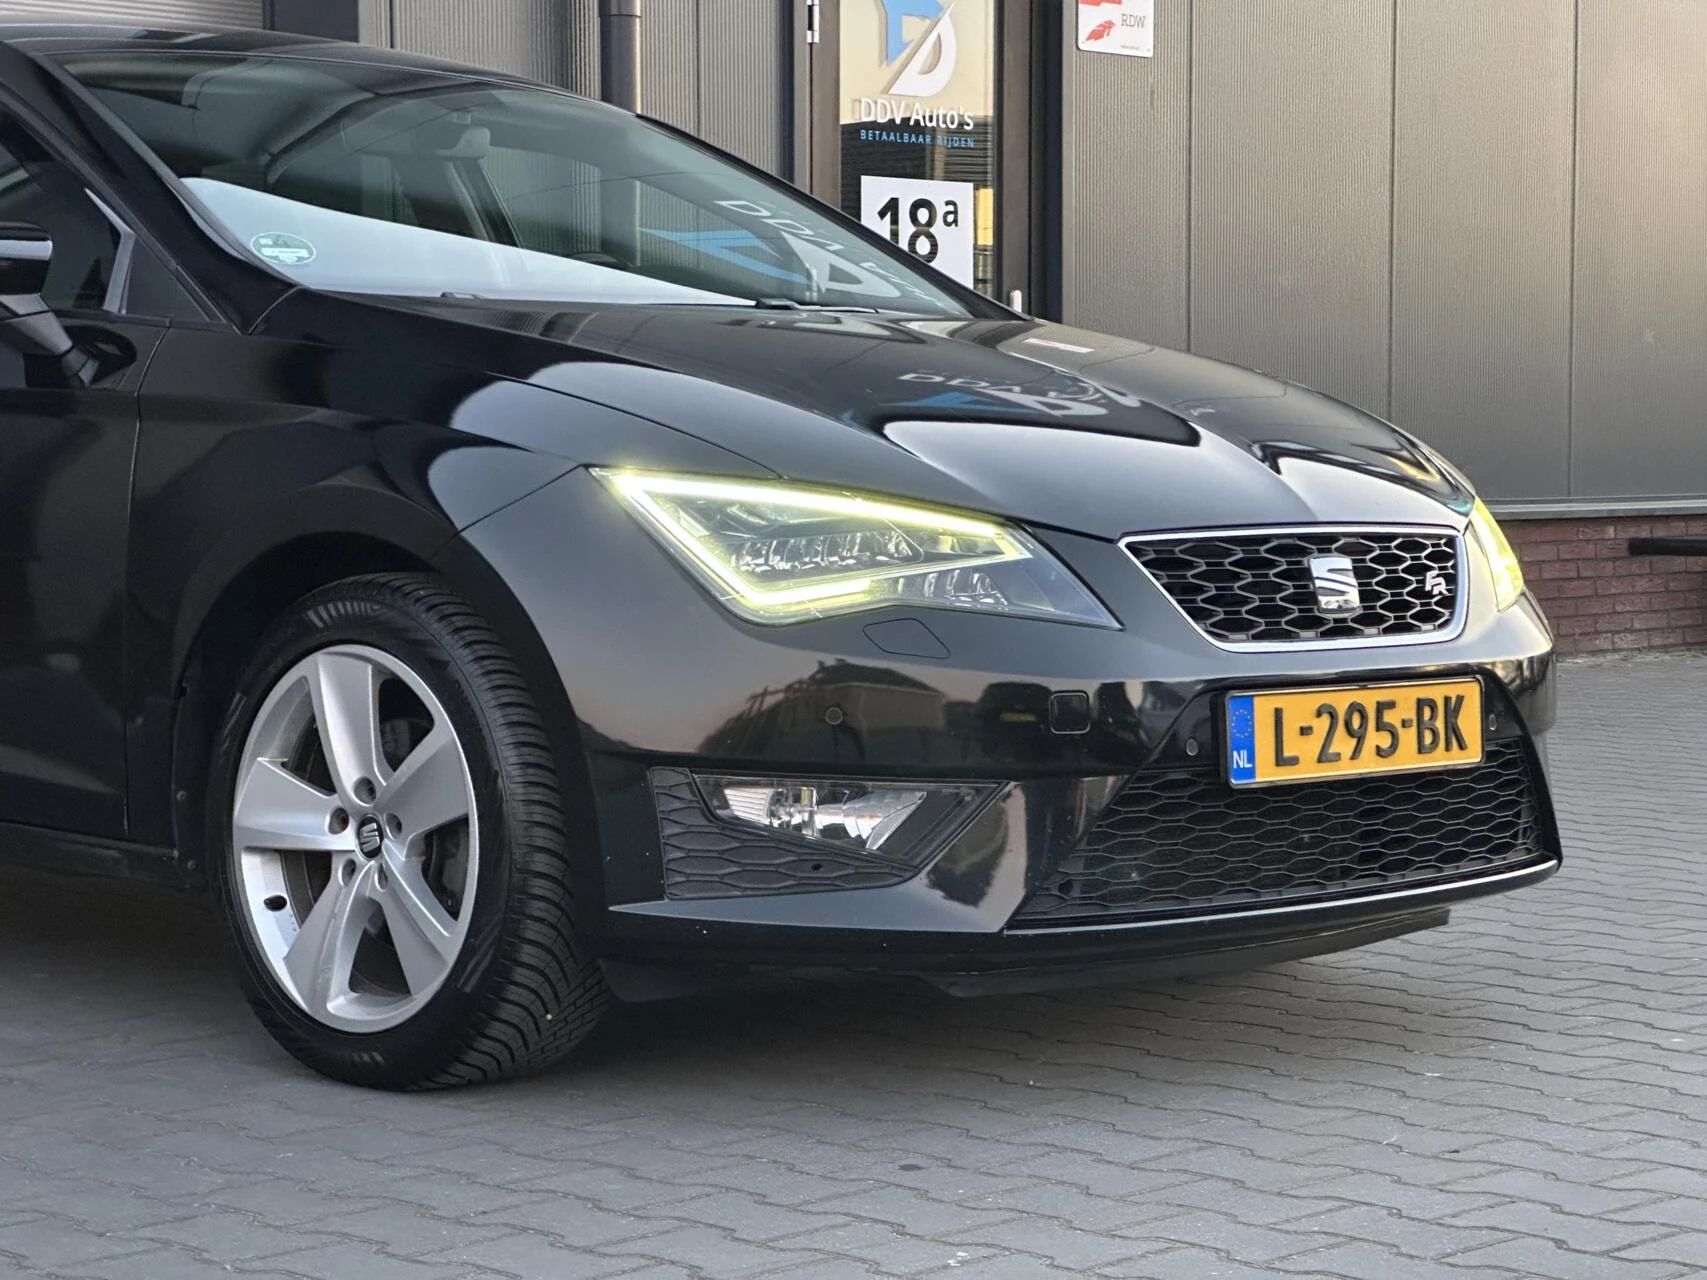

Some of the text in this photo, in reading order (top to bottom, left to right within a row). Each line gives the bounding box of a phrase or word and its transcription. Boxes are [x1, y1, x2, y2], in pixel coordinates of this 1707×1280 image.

[1121, 14, 1146, 28] RDW
[860, 98, 974, 130] DDV Auto's
[860, 130, 976, 148] BETAALBAAR RIJDEN
[1274, 694, 1468, 767] L-295-BK
[1233, 750, 1253, 769] NL
